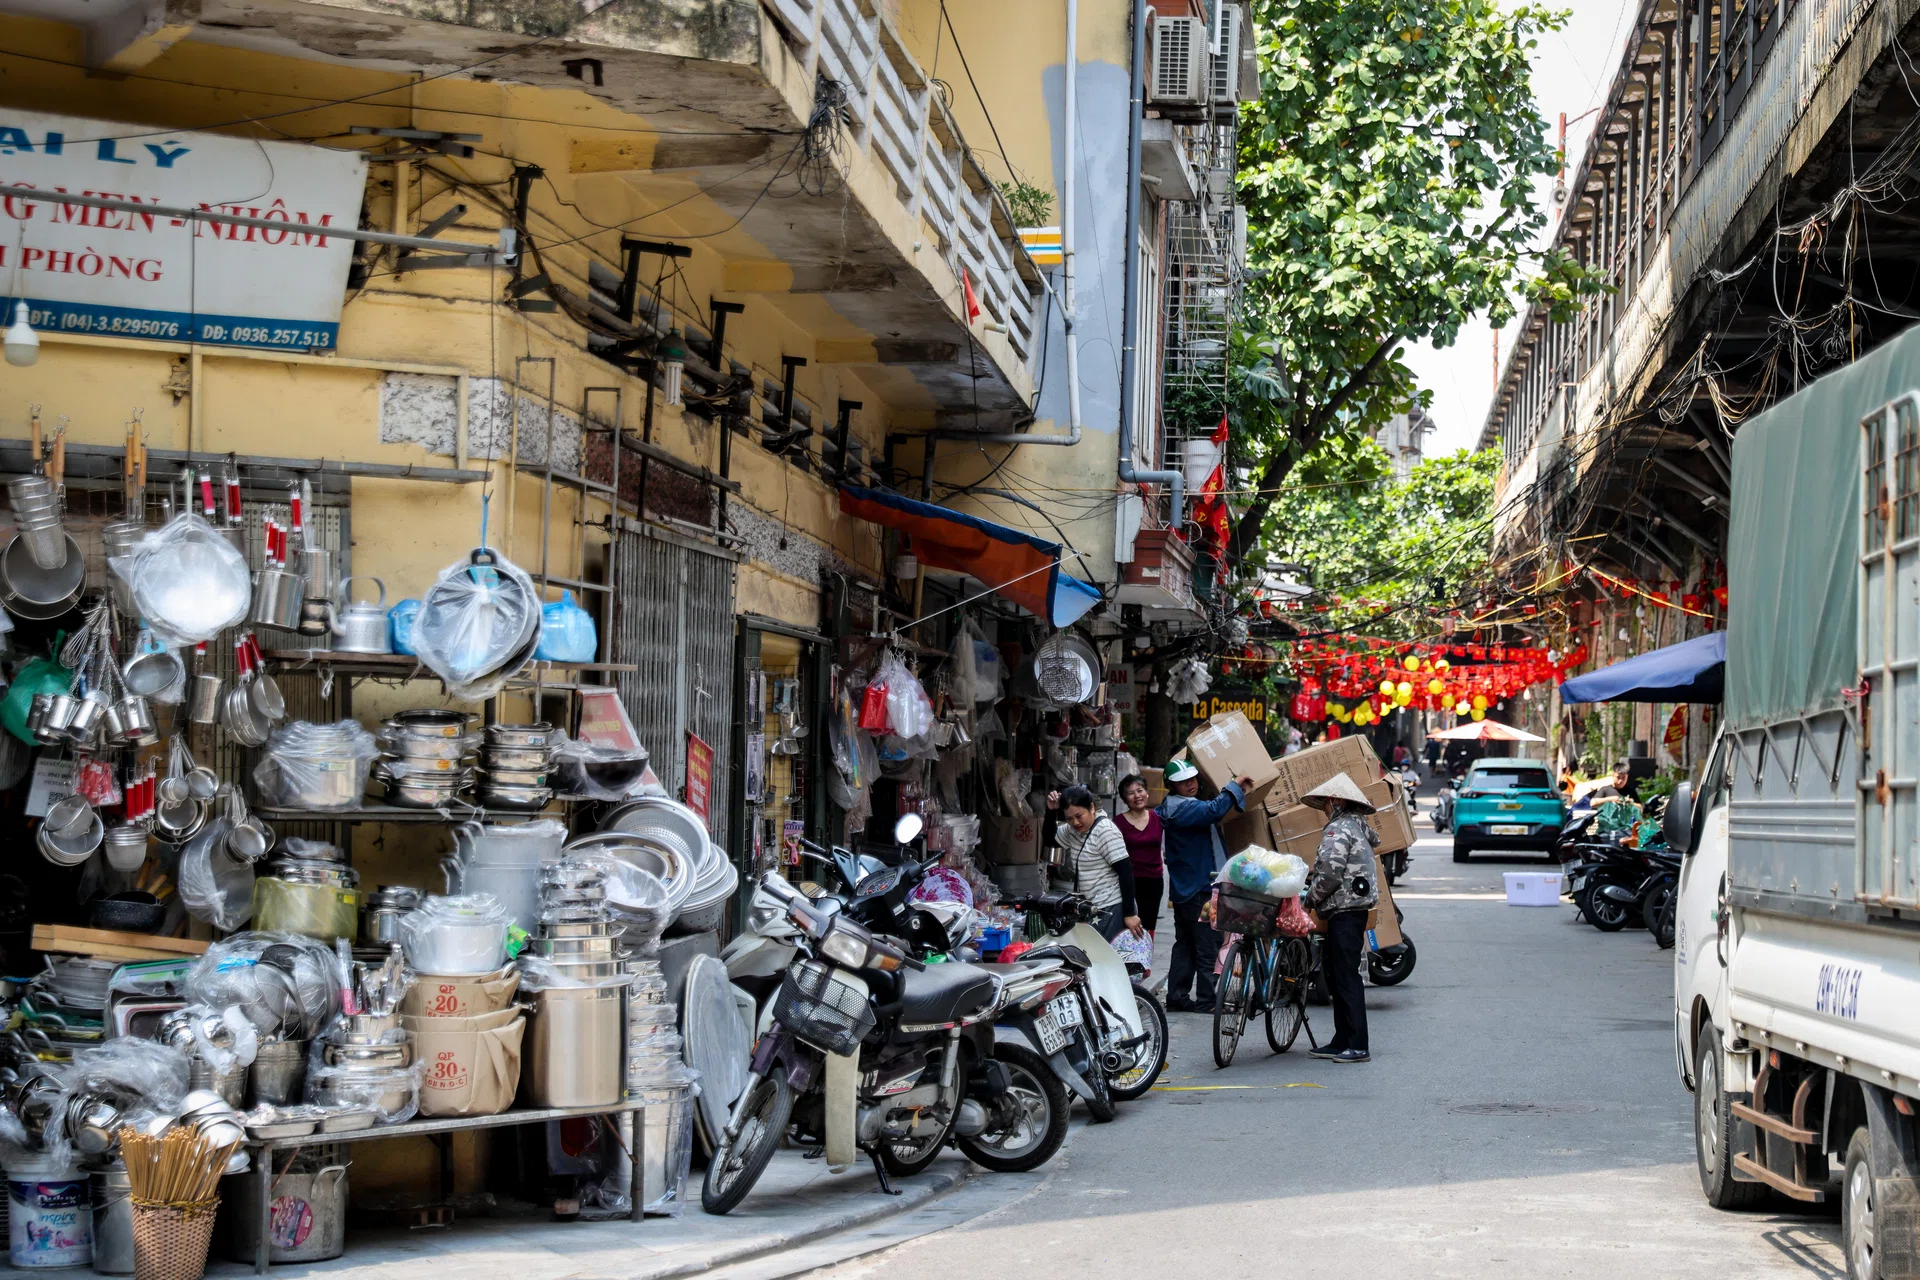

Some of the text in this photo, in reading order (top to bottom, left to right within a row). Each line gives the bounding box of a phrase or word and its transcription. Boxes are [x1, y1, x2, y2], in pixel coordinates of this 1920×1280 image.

[97, 140, 192, 168] LÝ
[0, 181, 37, 221] G
[50, 187, 160, 234] MEN
[193, 199, 334, 248] NHÔM
[19, 246, 164, 282] PHÒNG
[61, 312, 179, 337] (04)-3.8295076
[202, 324, 229, 341] DĐ:
[231, 326, 330, 347] 0936.257.513
[1193, 700, 1207, 719] La
[1026, 948, 1051, 958] HONDA
[439, 984, 456, 994] QP
[435, 995, 458, 1012] 20
[437, 1052, 455, 1061] QP
[435, 1062, 458, 1079] 30
